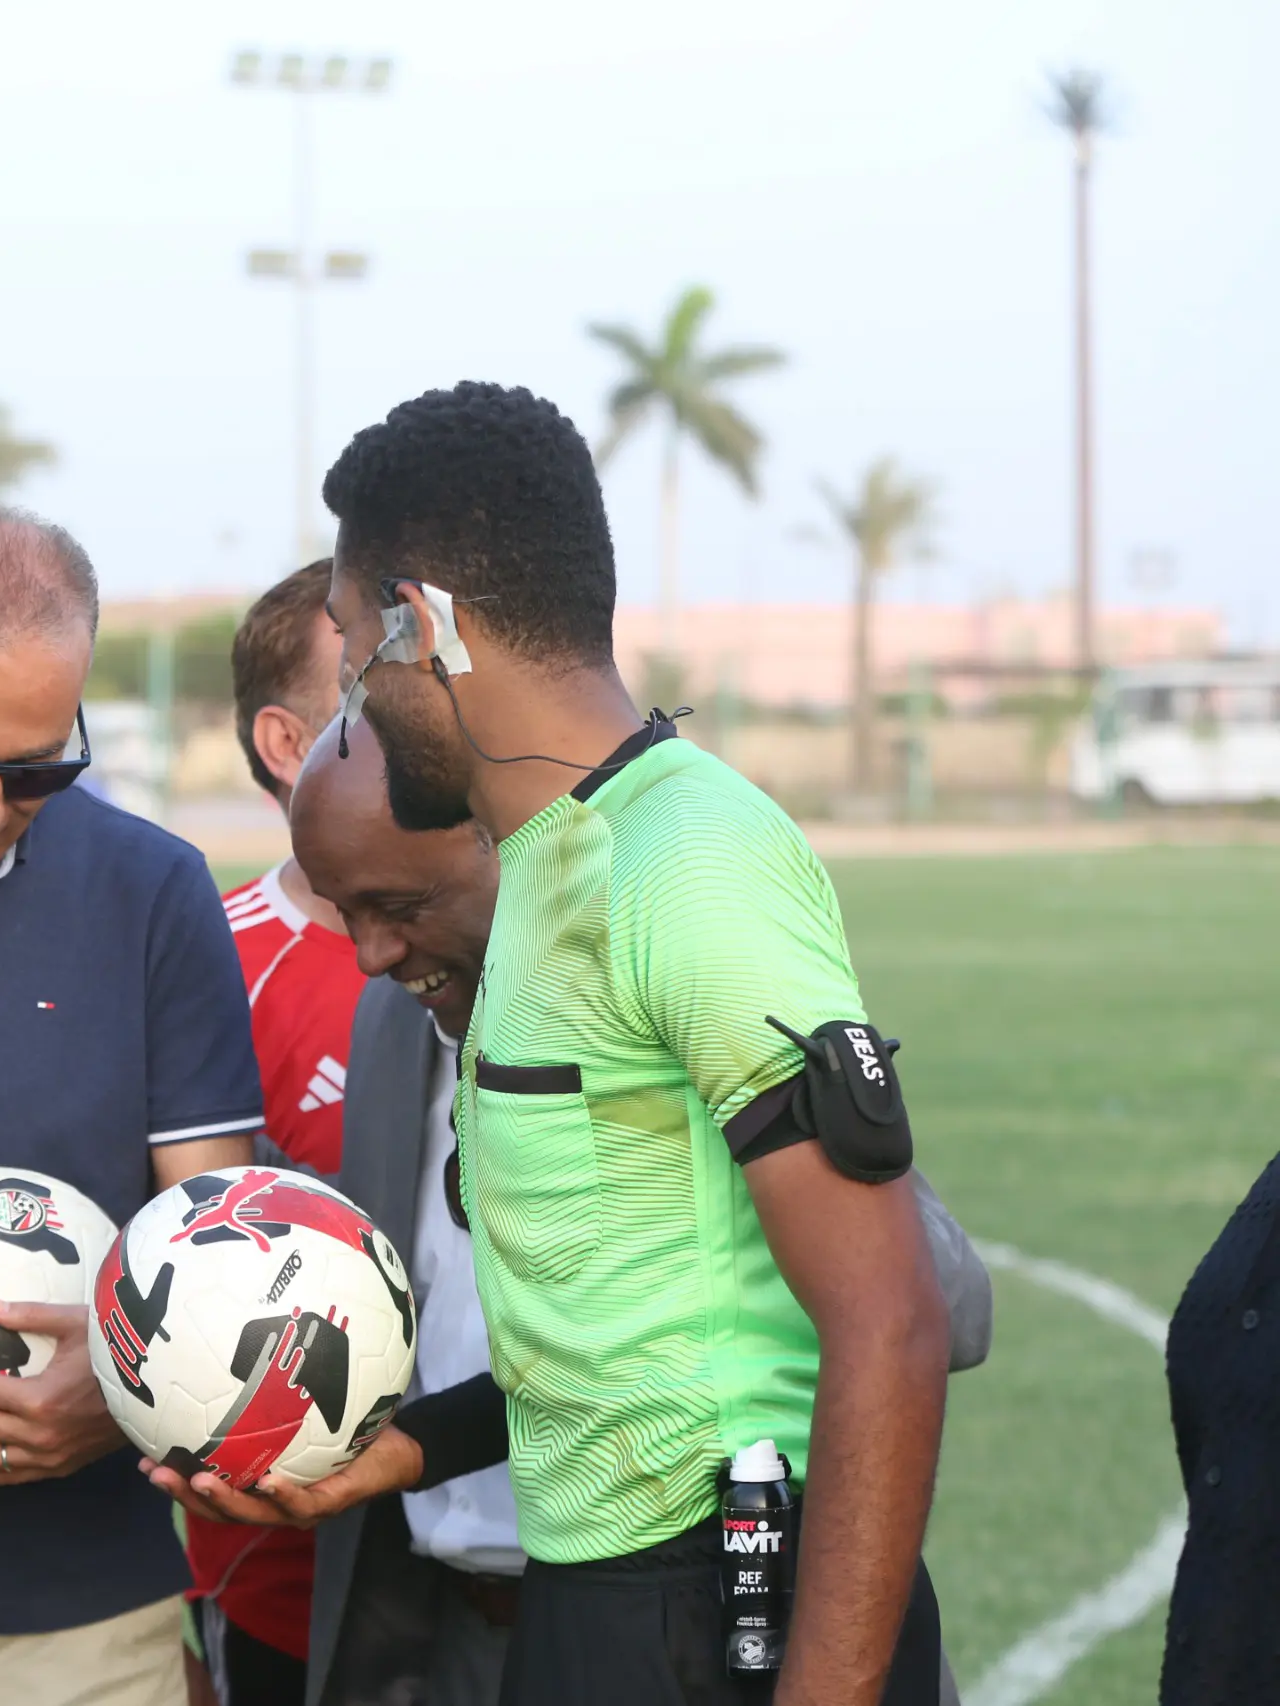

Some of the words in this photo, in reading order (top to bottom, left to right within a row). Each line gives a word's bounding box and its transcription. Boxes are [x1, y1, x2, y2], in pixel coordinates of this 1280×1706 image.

[843, 1027, 884, 1081] EJEAS
[266, 1249, 302, 1304] ORBITA
[738, 1570, 763, 1585] REF
